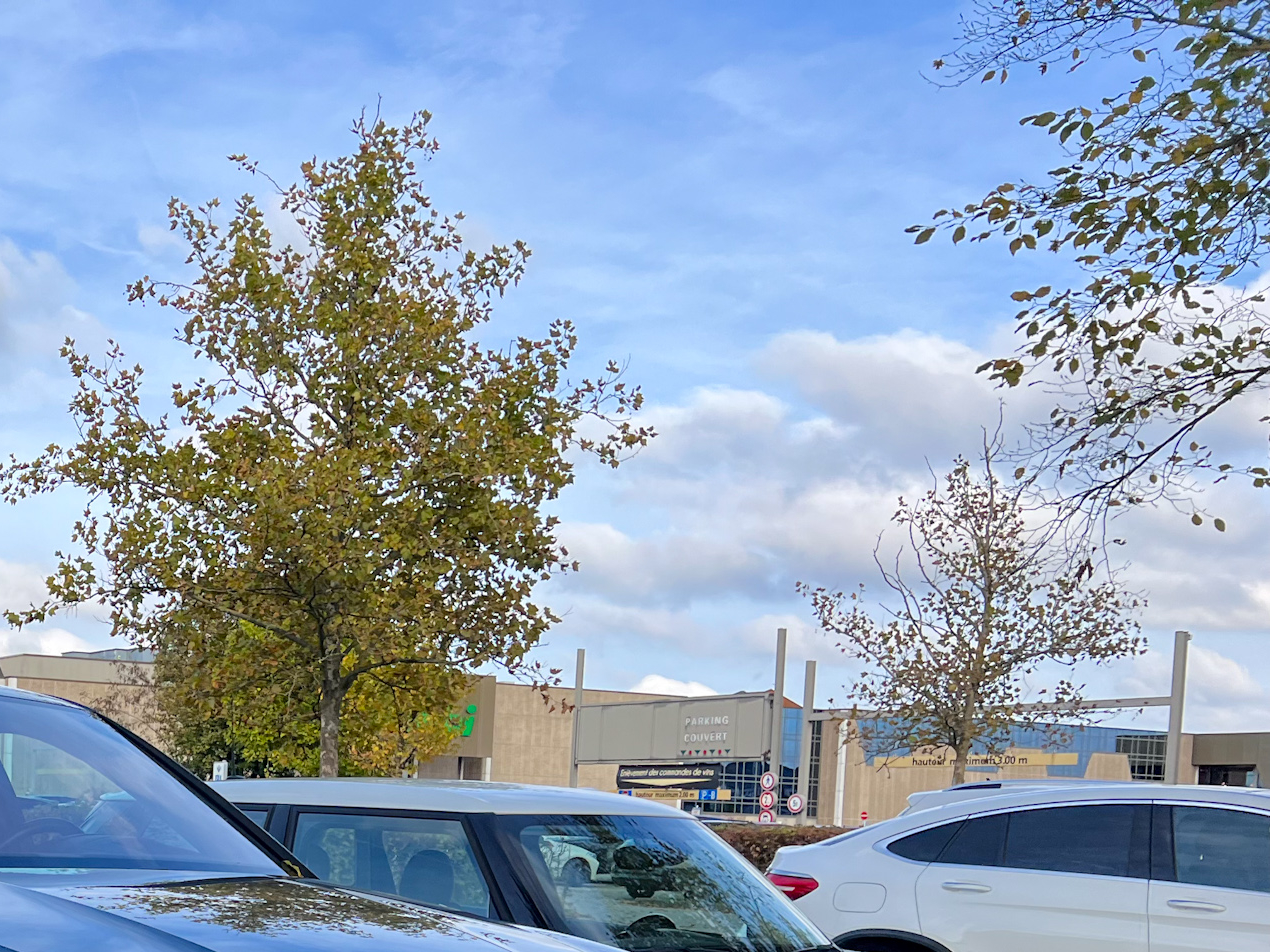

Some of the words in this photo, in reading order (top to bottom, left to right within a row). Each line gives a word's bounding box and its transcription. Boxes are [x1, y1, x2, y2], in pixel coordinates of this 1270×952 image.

[685, 715, 729, 726] PARKING
[684, 732, 728, 743] COUVERT
[649, 768, 659, 776] des
[659, 768, 692, 776] commandes
[693, 768, 701, 776] de
[702, 768, 715, 776] vins
